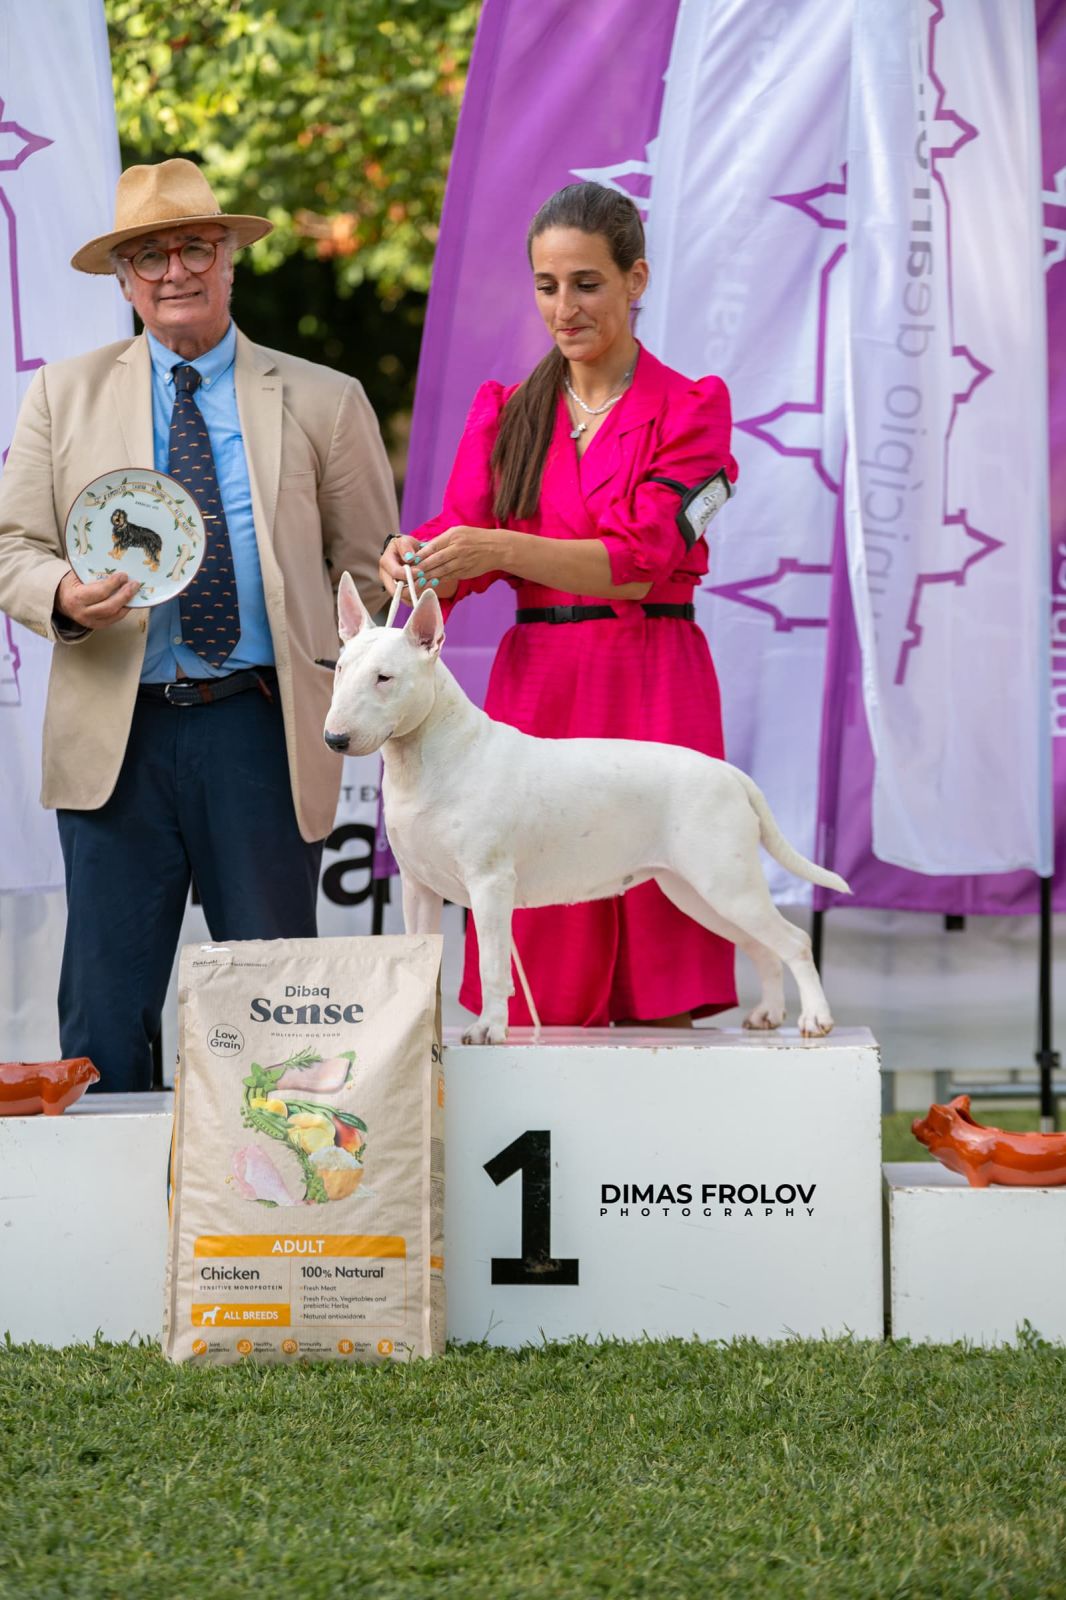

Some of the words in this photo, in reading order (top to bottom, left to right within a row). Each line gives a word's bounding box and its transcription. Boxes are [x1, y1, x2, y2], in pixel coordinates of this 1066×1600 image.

[285, 985, 330, 998] Dibaq
[250, 998, 364, 1025] Sense
[215, 1029, 238, 1041] Low
[210, 1039, 241, 1051] Grain
[482, 1130, 579, 1285] 1
[271, 1239, 325, 1254] ADULT
[200, 1266, 260, 1281] Chicken
[301, 1266, 333, 1279] 100%
[335, 1266, 384, 1279] Natural
[224, 1311, 241, 1320] ALL
[243, 1311, 279, 1320] BREEDS
